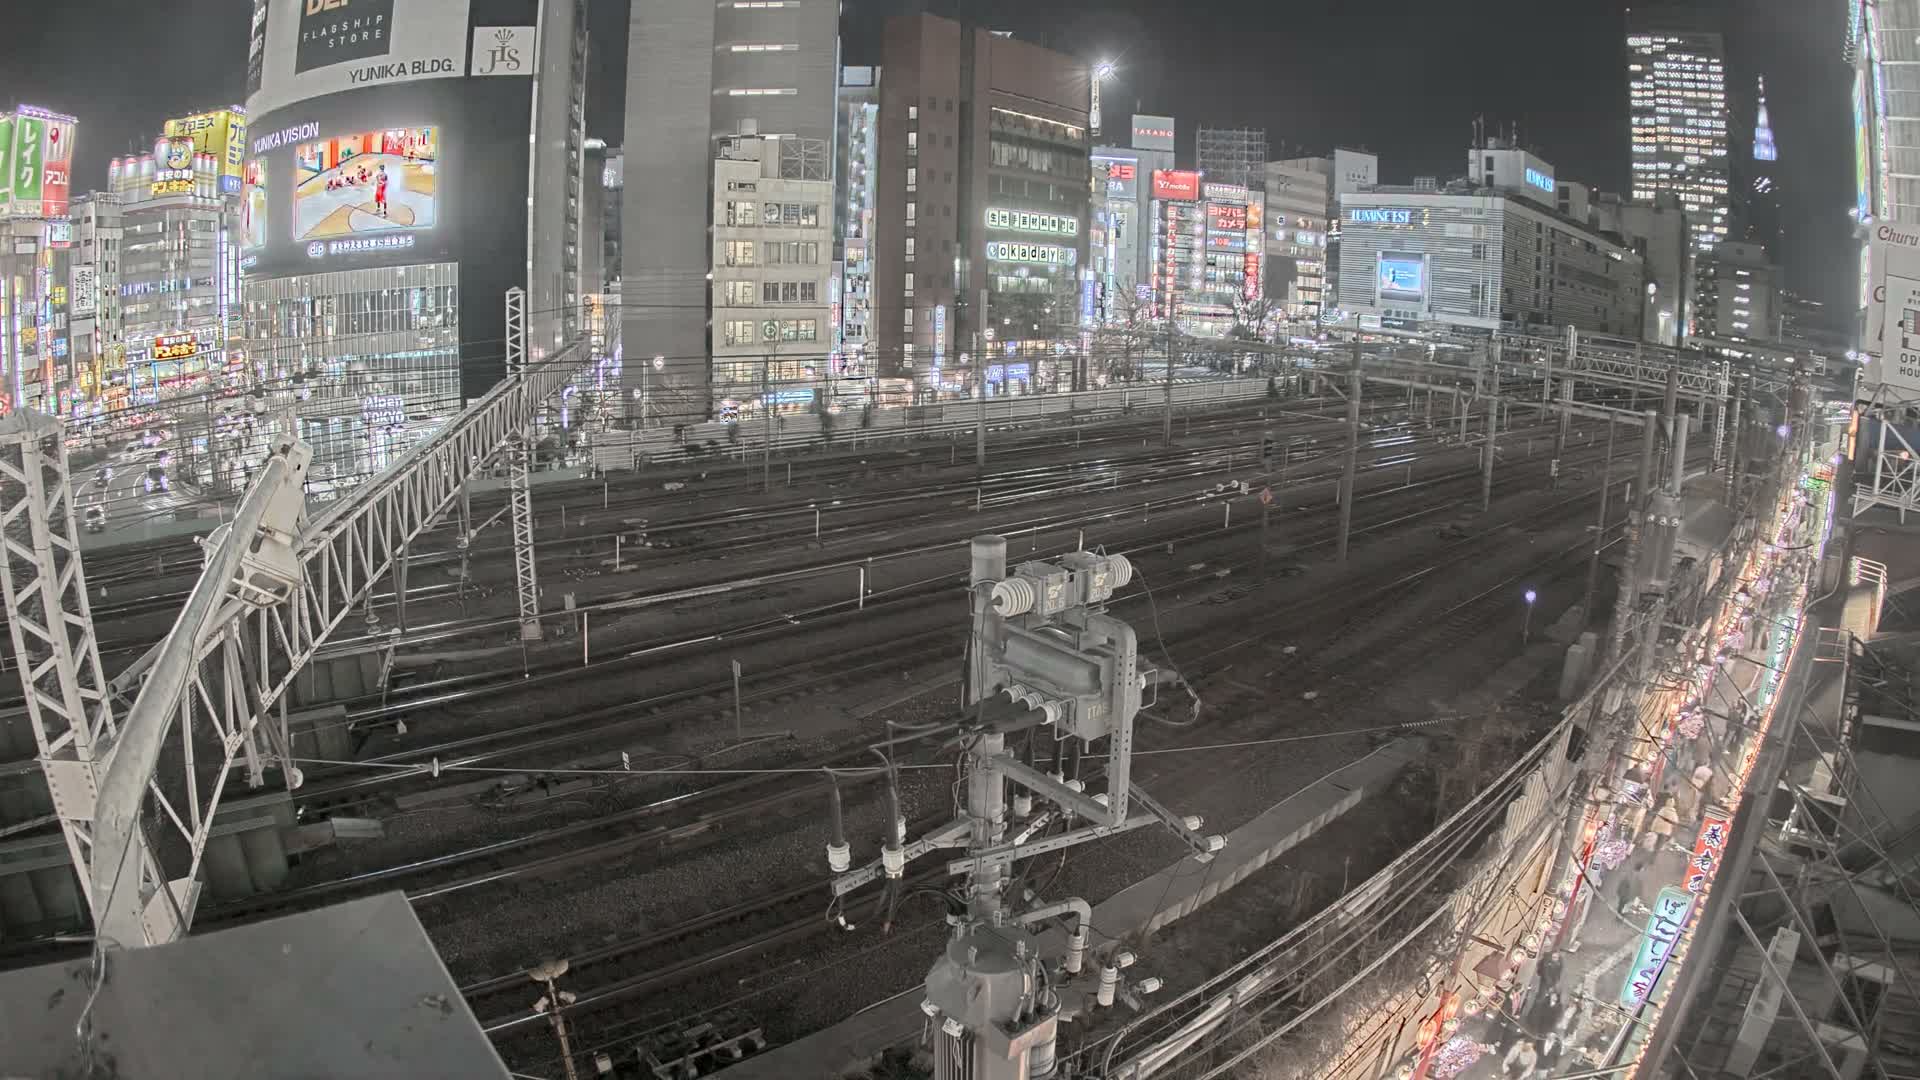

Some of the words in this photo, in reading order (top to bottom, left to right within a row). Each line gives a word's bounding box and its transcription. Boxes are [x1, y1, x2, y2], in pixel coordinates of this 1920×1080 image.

[303, 14, 383, 42] FLAGSHIP
[328, 29, 382, 48] STORE
[350, 62, 407, 84] YUNIKA
[411, 58, 455, 75] BLDG.
[254, 132, 281, 153] YUNIKA
[282, 121, 320, 144] VISION
[21, 121, 37, 188] レイク
[1208, 206, 1246, 217] ヨドバシ
[1352, 209, 1389, 222] LUMINE
[1392, 210, 1410, 223] EST
[1218, 218, 1246, 229] カメラ
[310, 240, 324, 256] dip
[1000, 246, 1065, 263] okadaya
